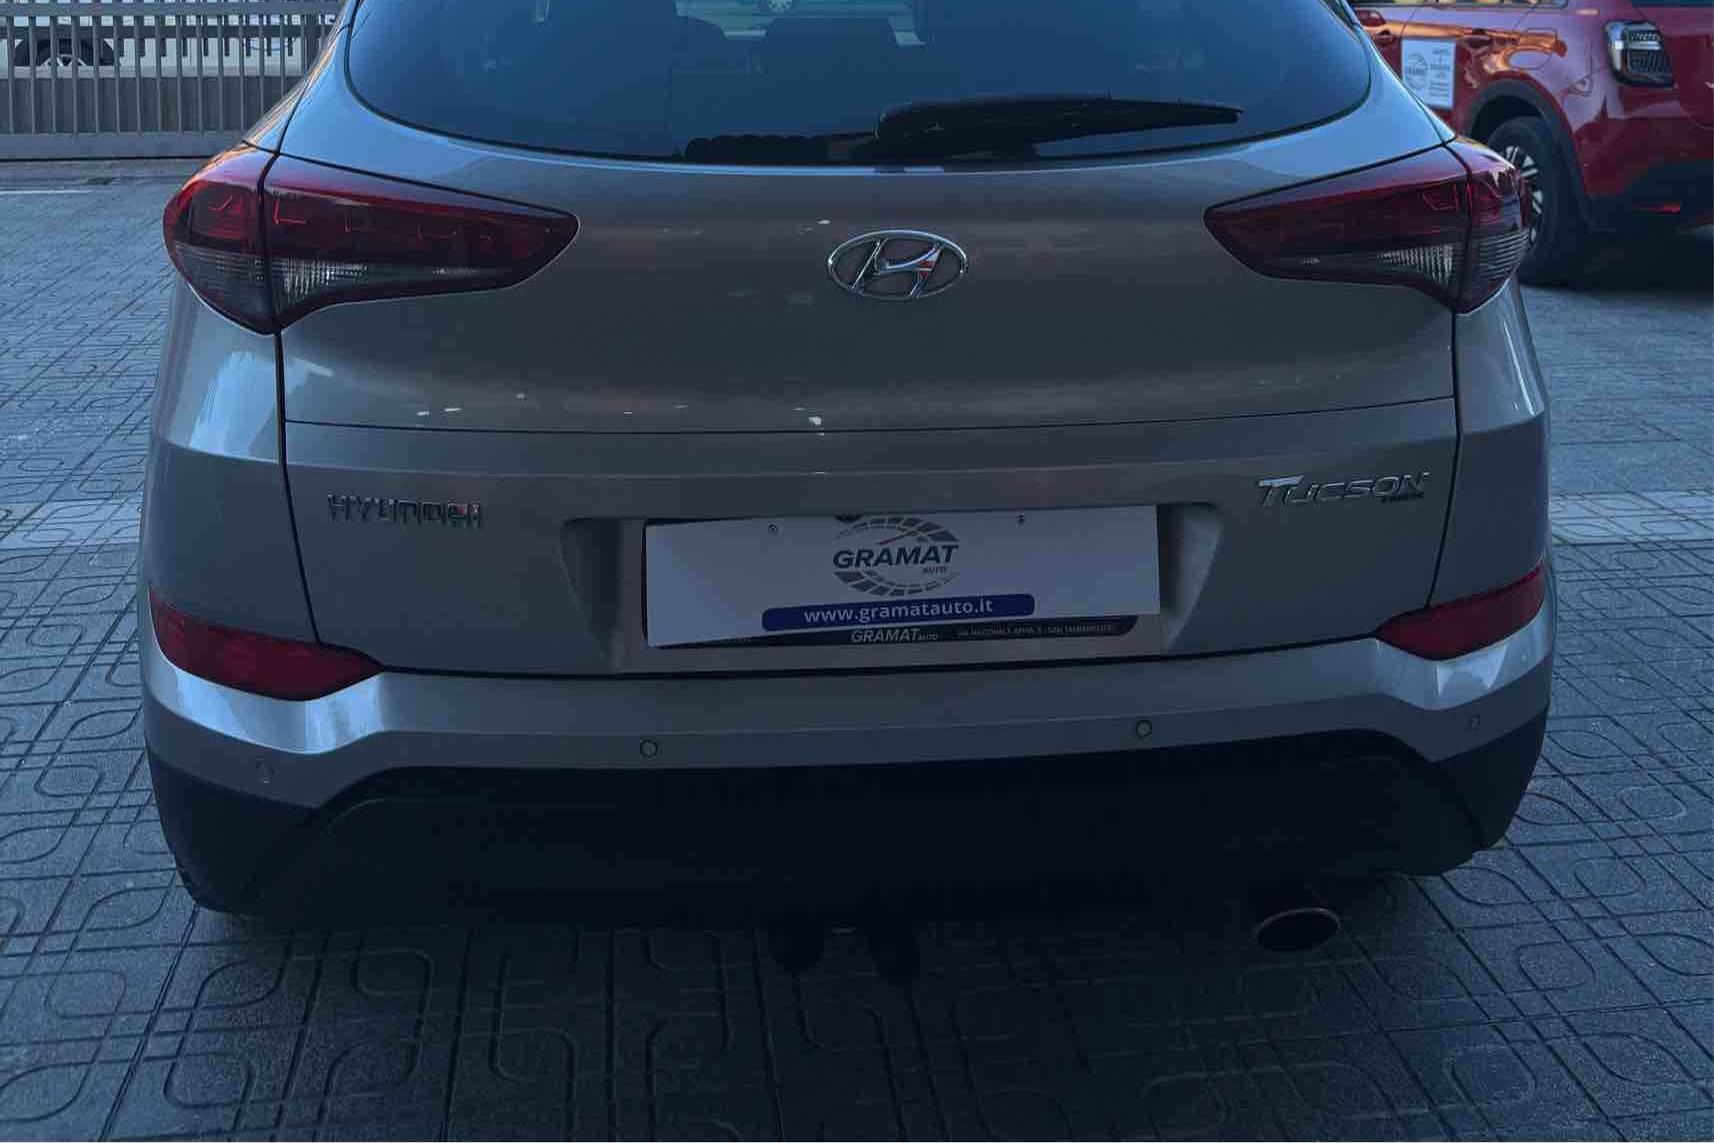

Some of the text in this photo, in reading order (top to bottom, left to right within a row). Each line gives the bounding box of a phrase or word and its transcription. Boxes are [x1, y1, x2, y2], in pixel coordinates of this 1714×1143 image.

[1257, 472, 1431, 507] TUCSON
[832, 544, 959, 570] GRAMAT
[803, 598, 994, 625] www.gramatauto.it
[850, 627, 921, 644] GRAMAT
